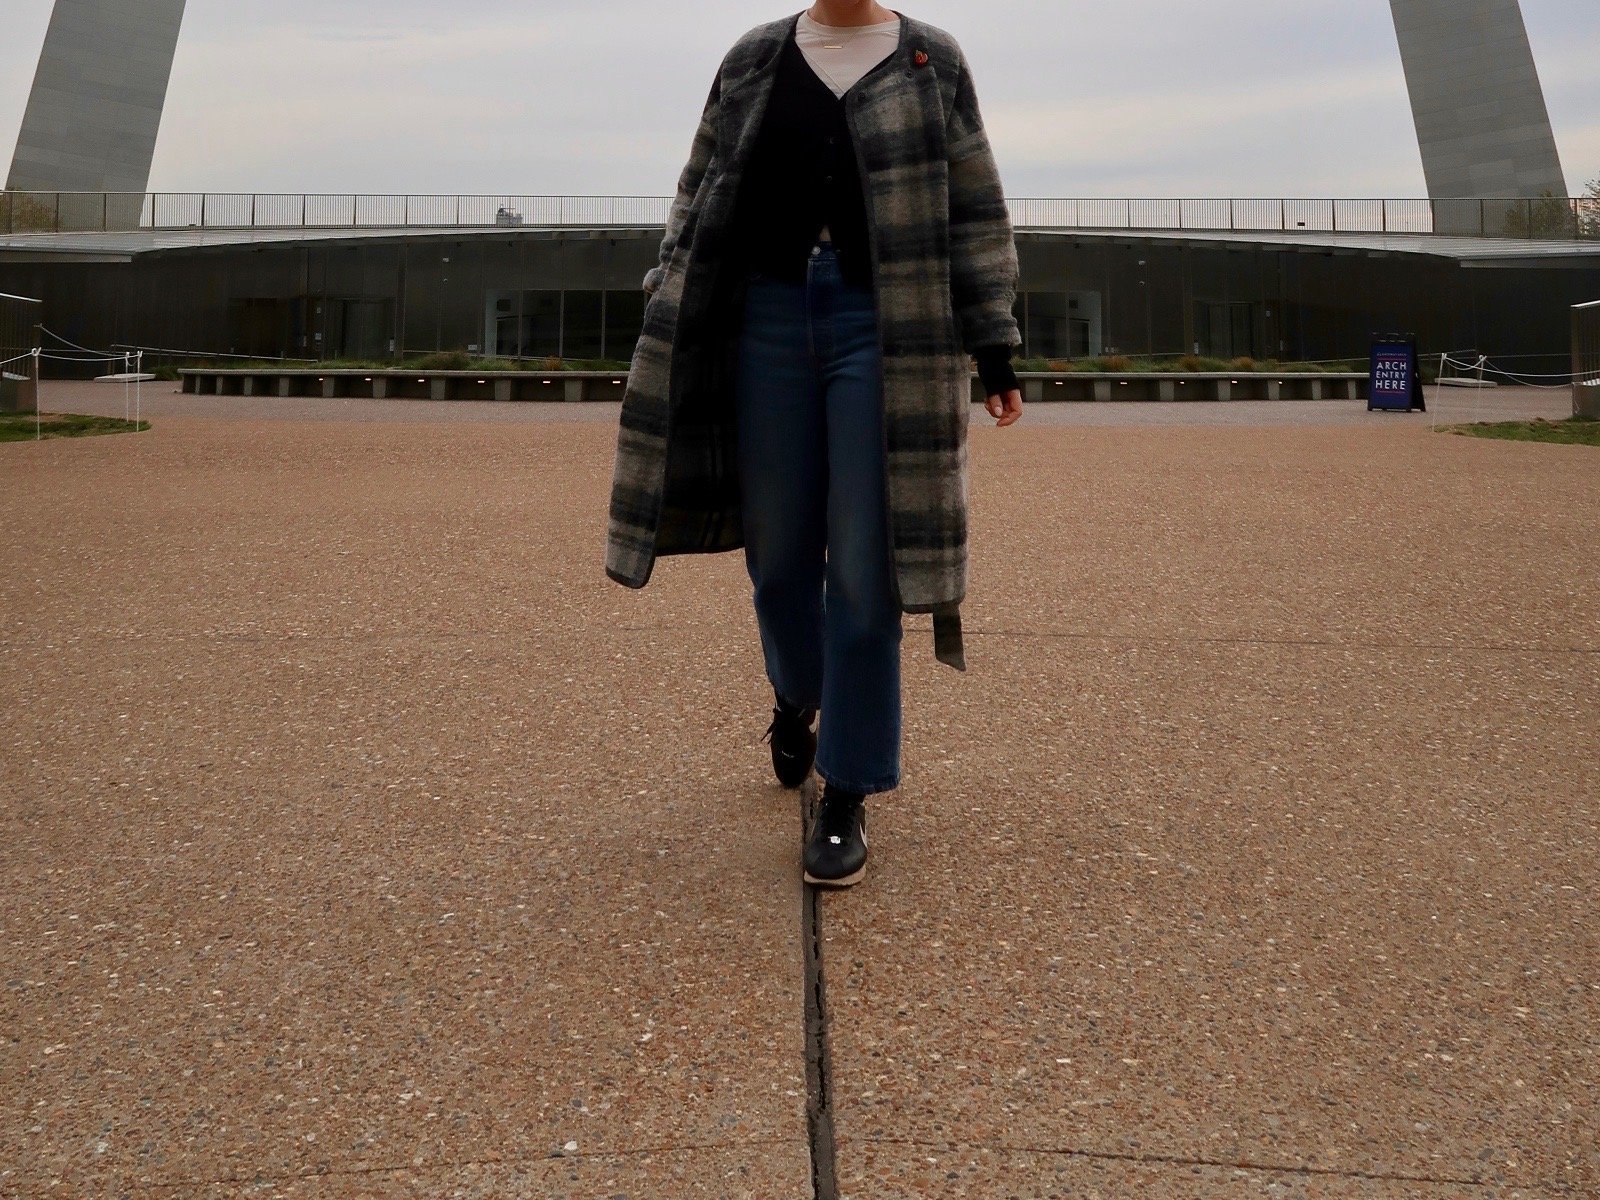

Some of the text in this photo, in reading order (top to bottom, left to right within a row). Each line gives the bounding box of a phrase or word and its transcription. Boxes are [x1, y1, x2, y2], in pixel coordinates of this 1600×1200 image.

[1376, 361, 1407, 370] ARCH
[1375, 370, 1406, 379] ENTRY
[1375, 379, 1406, 390] HERE
